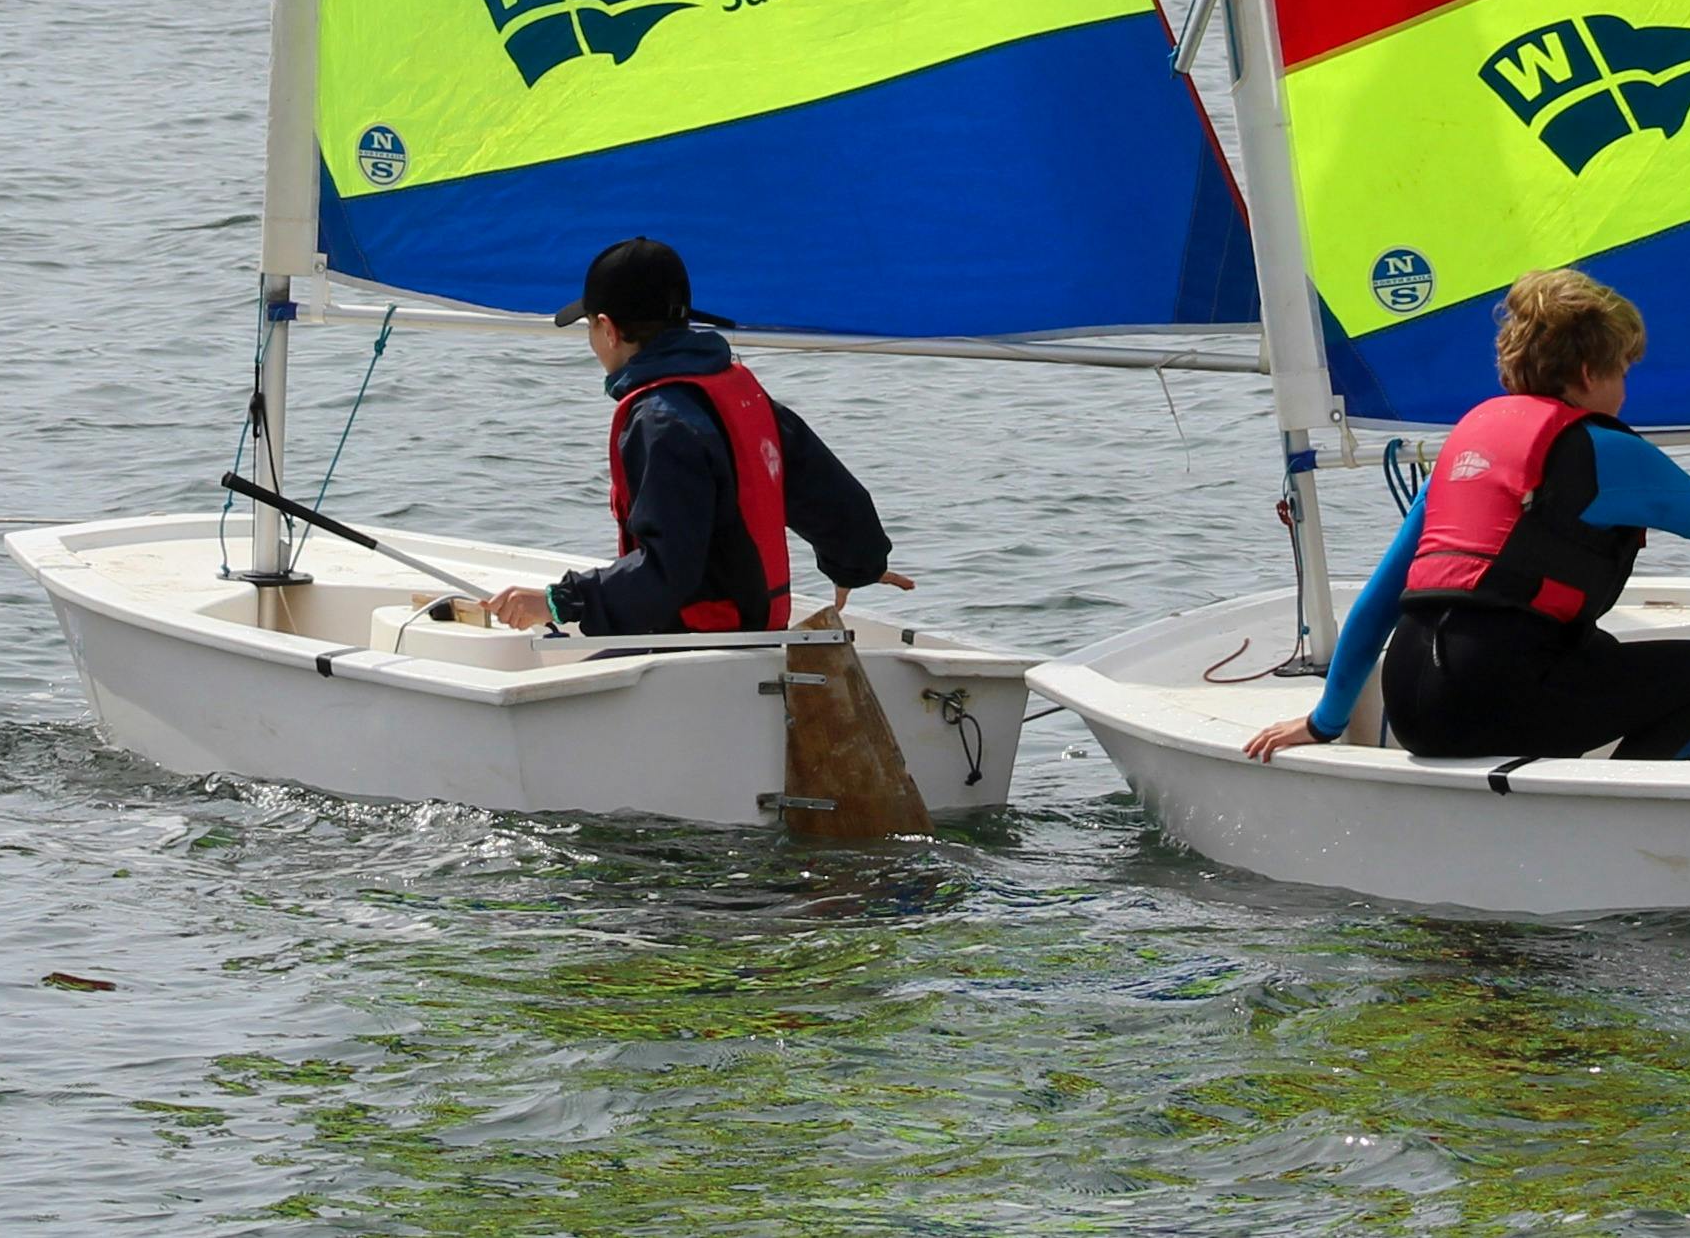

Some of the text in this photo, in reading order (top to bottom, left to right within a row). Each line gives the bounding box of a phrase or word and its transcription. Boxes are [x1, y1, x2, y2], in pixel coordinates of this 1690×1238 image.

[1495, 31, 1572, 103] W
[371, 131, 393, 150] N
[371, 162, 393, 178] S
[1384, 255, 1414, 275] N
[1391, 286, 1419, 305] S
